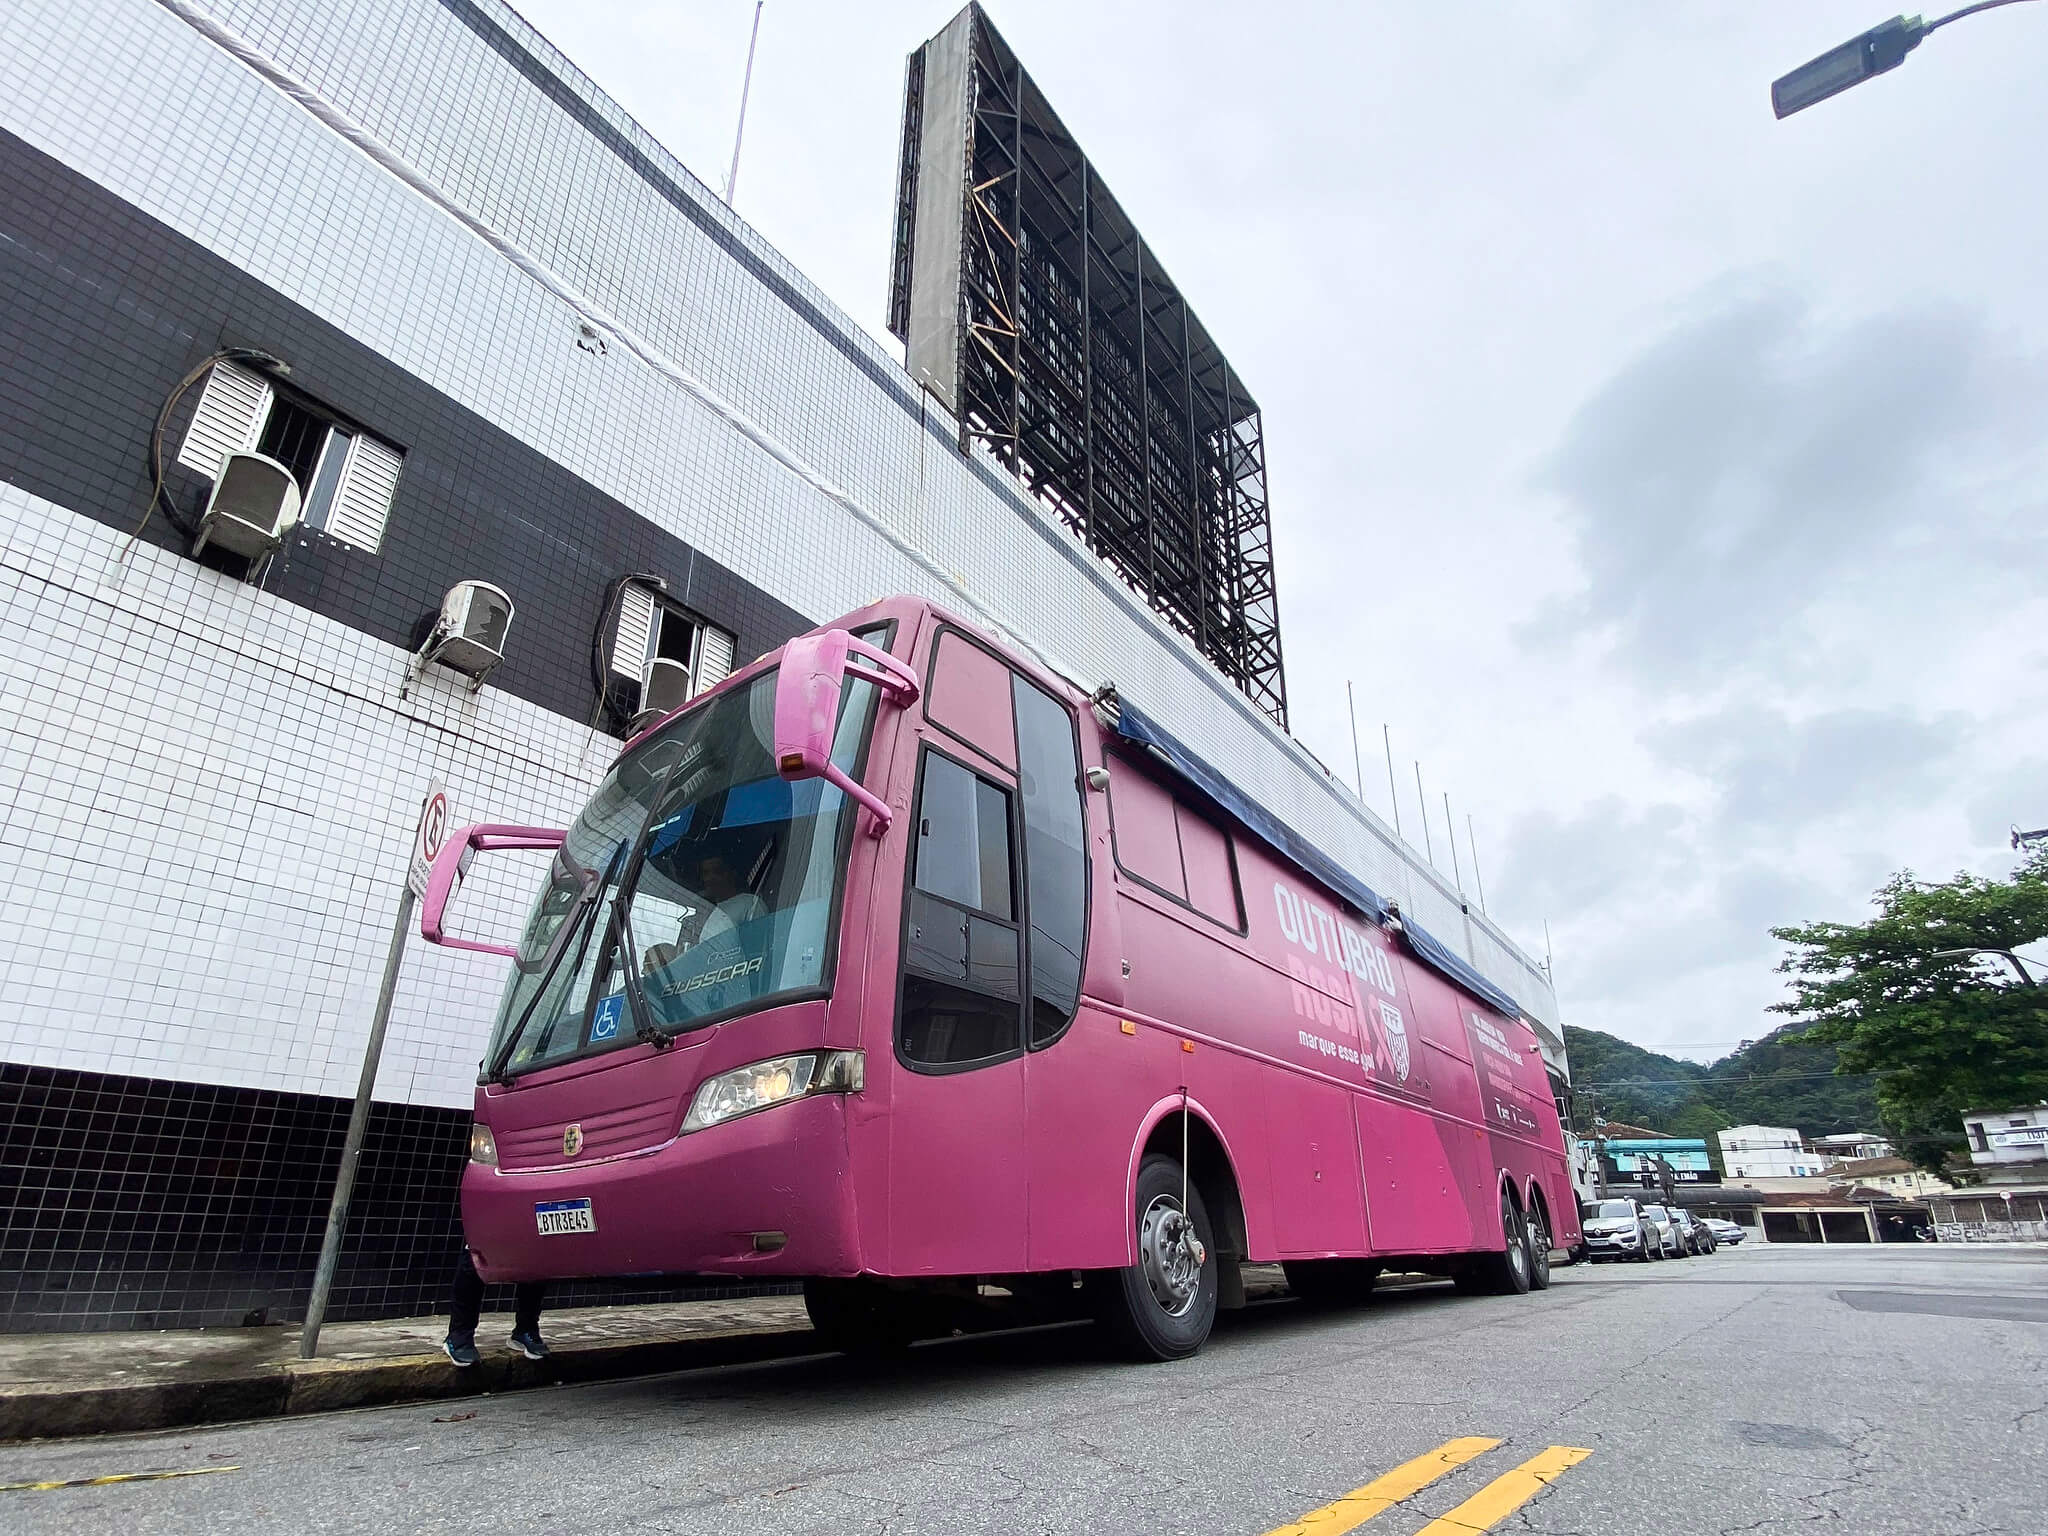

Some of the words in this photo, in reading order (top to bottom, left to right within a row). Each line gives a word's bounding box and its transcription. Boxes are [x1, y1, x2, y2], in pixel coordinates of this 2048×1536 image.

[1273, 882, 1396, 997] OUTUBRO
[661, 957, 763, 997] BUSSCAR
[1287, 953, 1371, 1042] ROSA
[1298, 1030, 1337, 1057] marque
[1338, 1044, 1360, 1065] esse
[542, 1211, 588, 1232] BTR3E45
